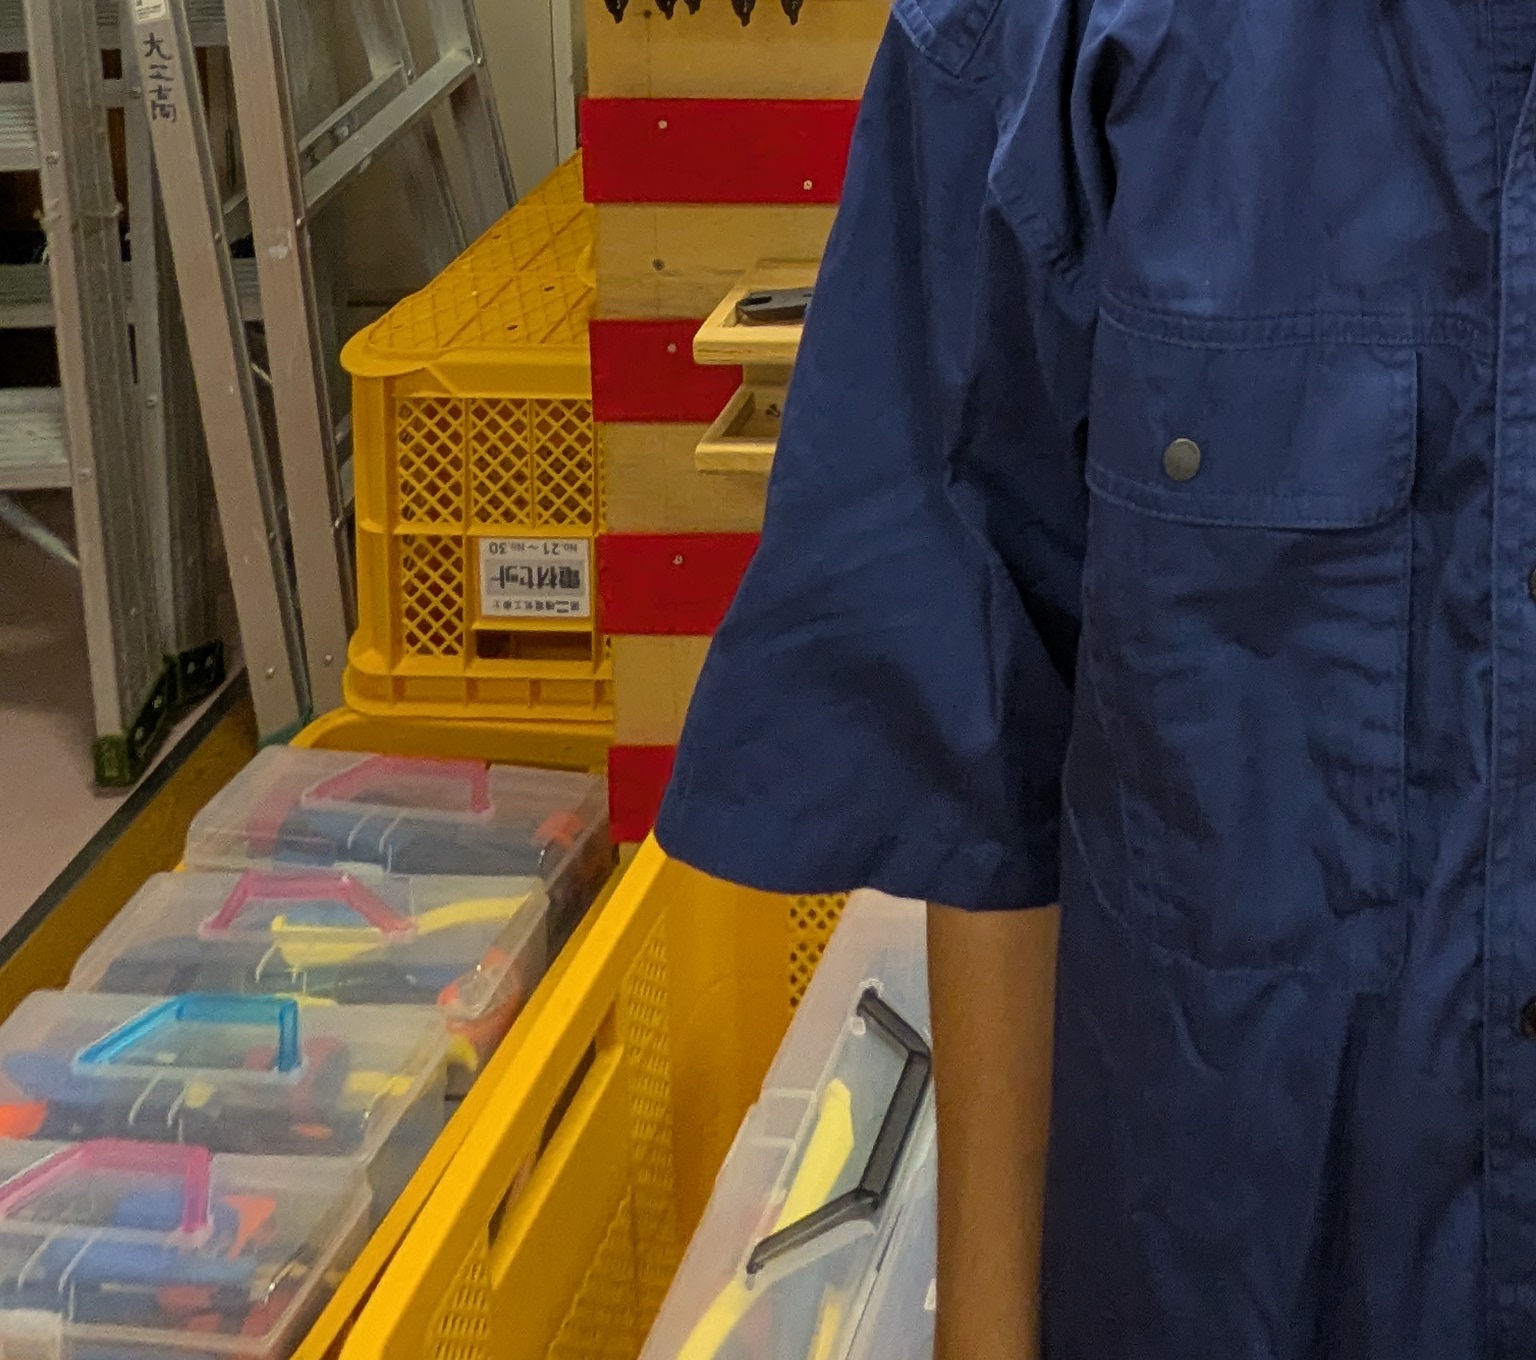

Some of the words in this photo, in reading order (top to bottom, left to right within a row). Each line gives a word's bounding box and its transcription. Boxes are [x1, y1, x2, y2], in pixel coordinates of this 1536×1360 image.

[490, 565, 580, 589] 電材セット
